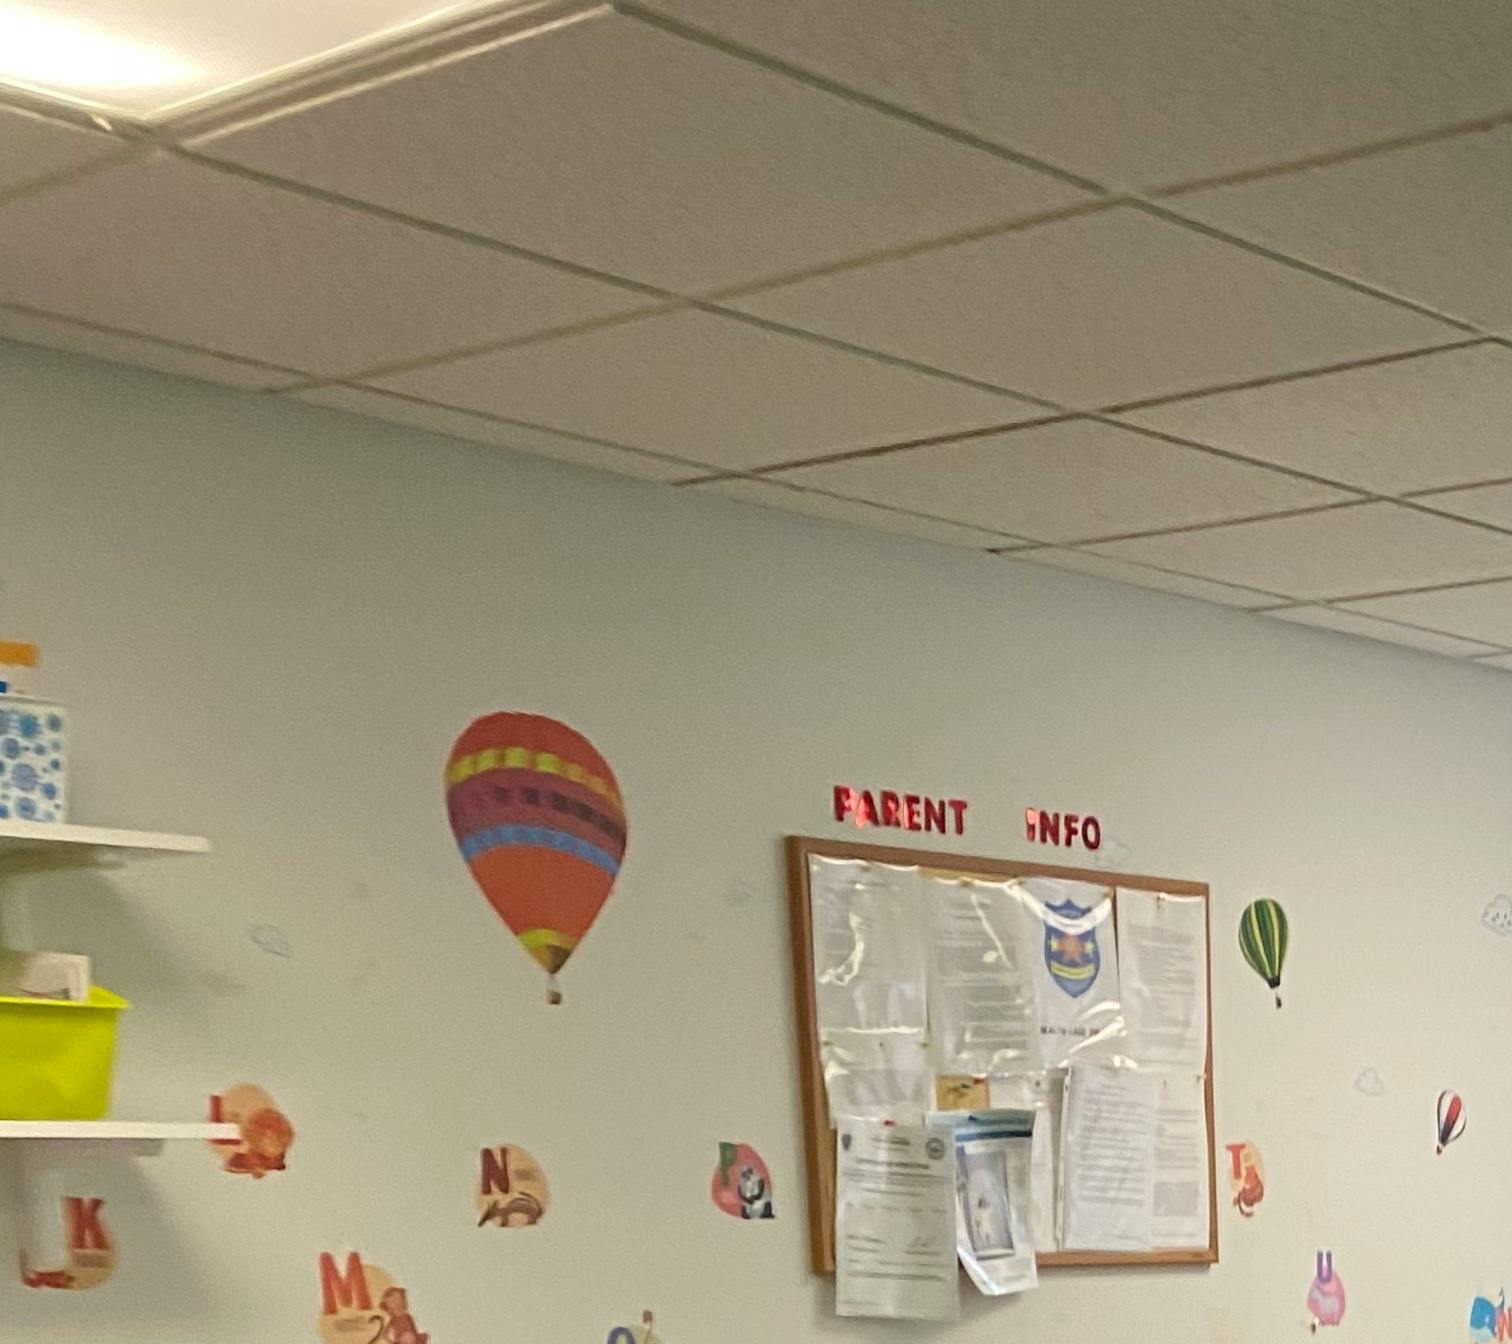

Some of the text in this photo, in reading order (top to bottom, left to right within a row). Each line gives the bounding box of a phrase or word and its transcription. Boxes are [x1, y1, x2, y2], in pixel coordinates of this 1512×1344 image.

[833, 784, 1101, 851] PARENT INFO
[480, 1147, 510, 1195] N
[1225, 1143, 1248, 1180] T
[66, 1196, 105, 1250] K
[319, 1251, 373, 1315] M
[1316, 1250, 1333, 1285] U
